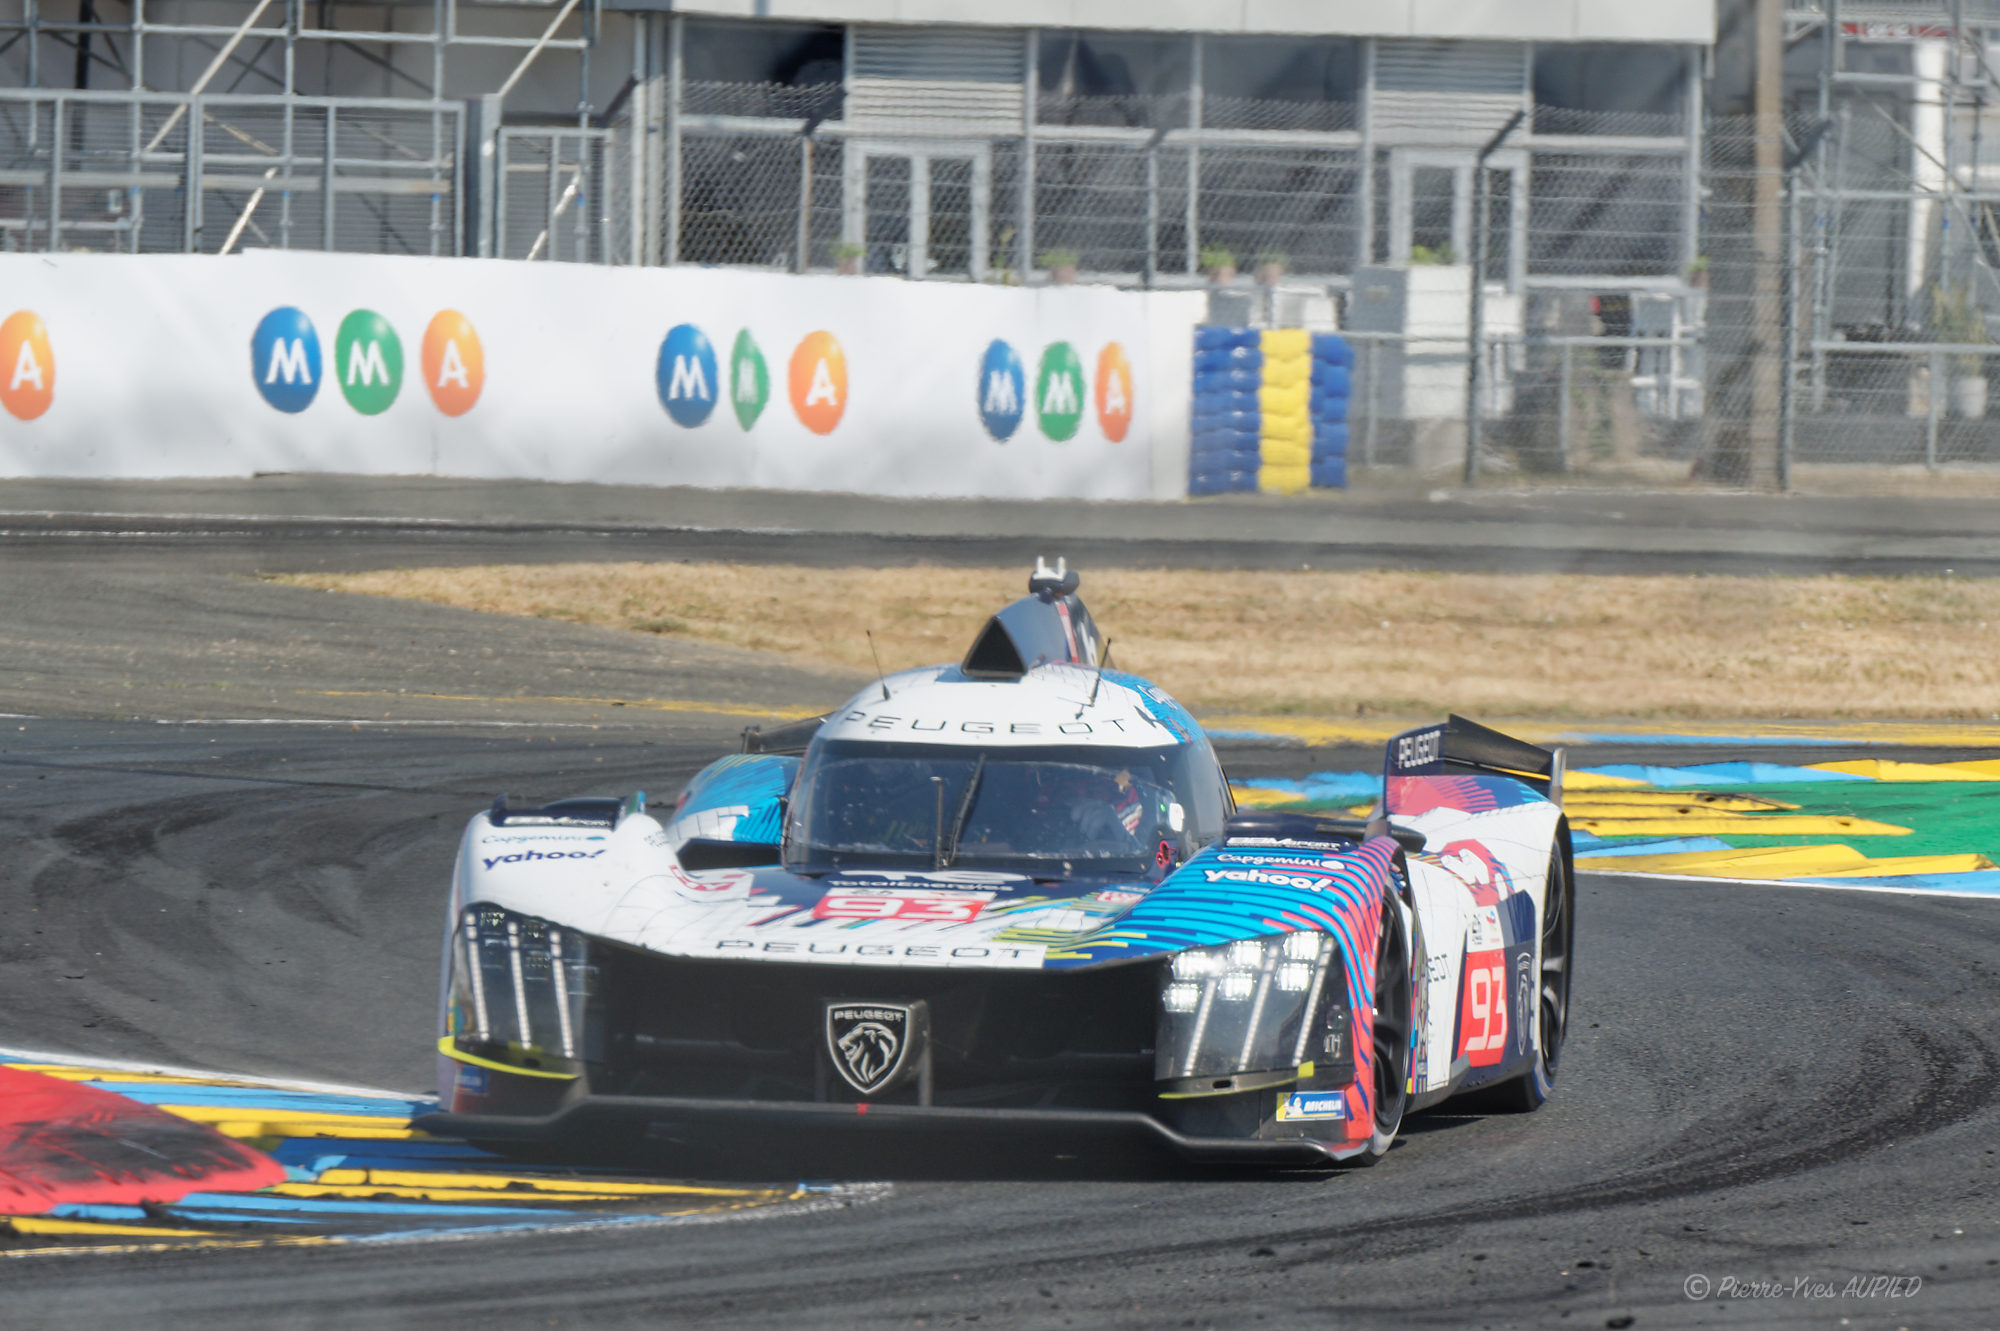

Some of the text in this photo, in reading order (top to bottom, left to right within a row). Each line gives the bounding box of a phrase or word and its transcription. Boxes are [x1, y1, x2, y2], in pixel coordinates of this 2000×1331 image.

[843, 711, 1125, 734] PEUGEOT
[1398, 730, 1440, 768] PEUGEOT
[482, 849, 607, 870] yahoo!
[1217, 854, 1320, 867] Capgemini
[828, 880, 1014, 891] TotalEnergies
[1204, 869, 1333, 892] yahoo!
[823, 898, 973, 919] 93
[716, 940, 1036, 959] PEUGEOT
[834, 1009, 904, 1022] PEUGEOT
[1464, 966, 1508, 1051] 93
